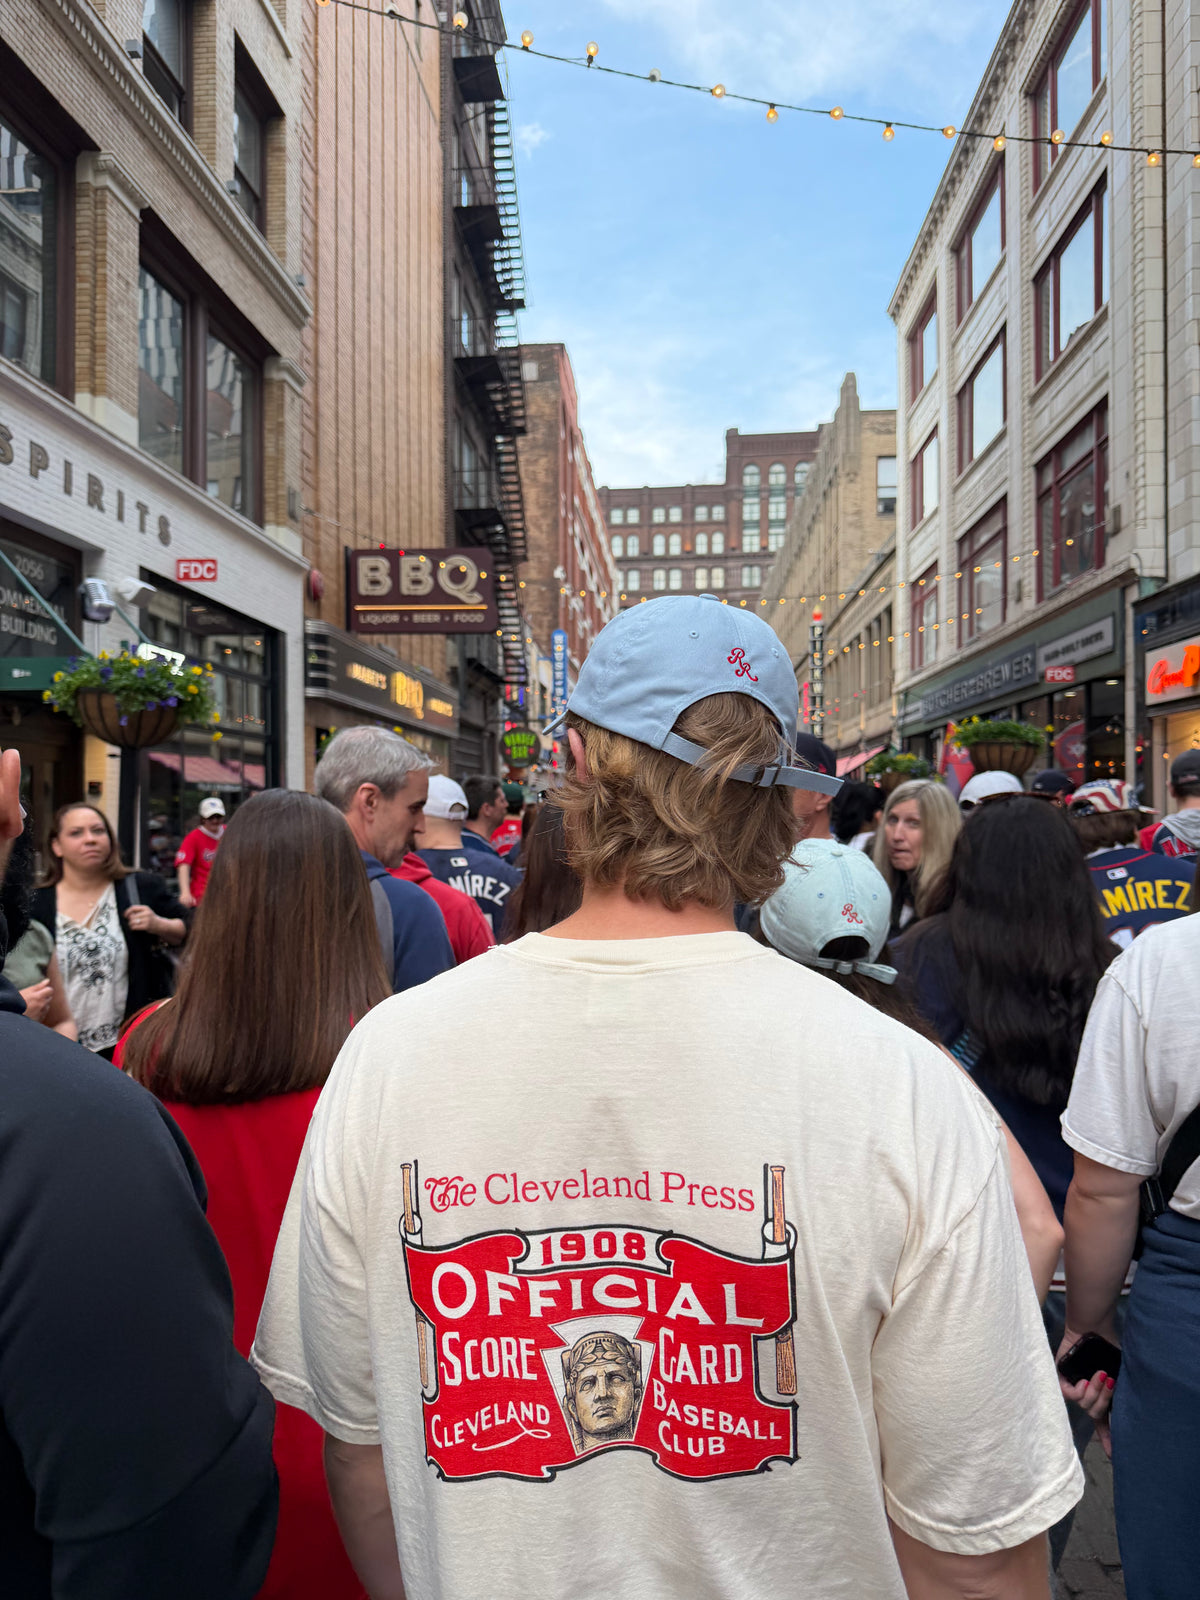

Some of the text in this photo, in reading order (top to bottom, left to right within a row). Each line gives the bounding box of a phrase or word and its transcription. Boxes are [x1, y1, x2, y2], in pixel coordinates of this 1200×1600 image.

[0, 423, 172, 546] SPIRITS
[178, 561, 216, 580] FDC
[357, 554, 484, 604] BBQ
[1, 613, 58, 645] BUILDING
[358, 612, 485, 625] LIQUOR BEER FOOD
[1045, 668, 1073, 681] FDC
[424, 1168, 756, 1212] The Cleveland Press
[540, 1231, 647, 1266] 1908
[431, 1261, 765, 1328] OFFICIAL
[440, 1326, 743, 1386] SCORE CARD
[431, 1401, 551, 1449] CLEVELAND
[653, 1378, 783, 1440] BASEBALL
[658, 1423, 726, 1457] CLUB
